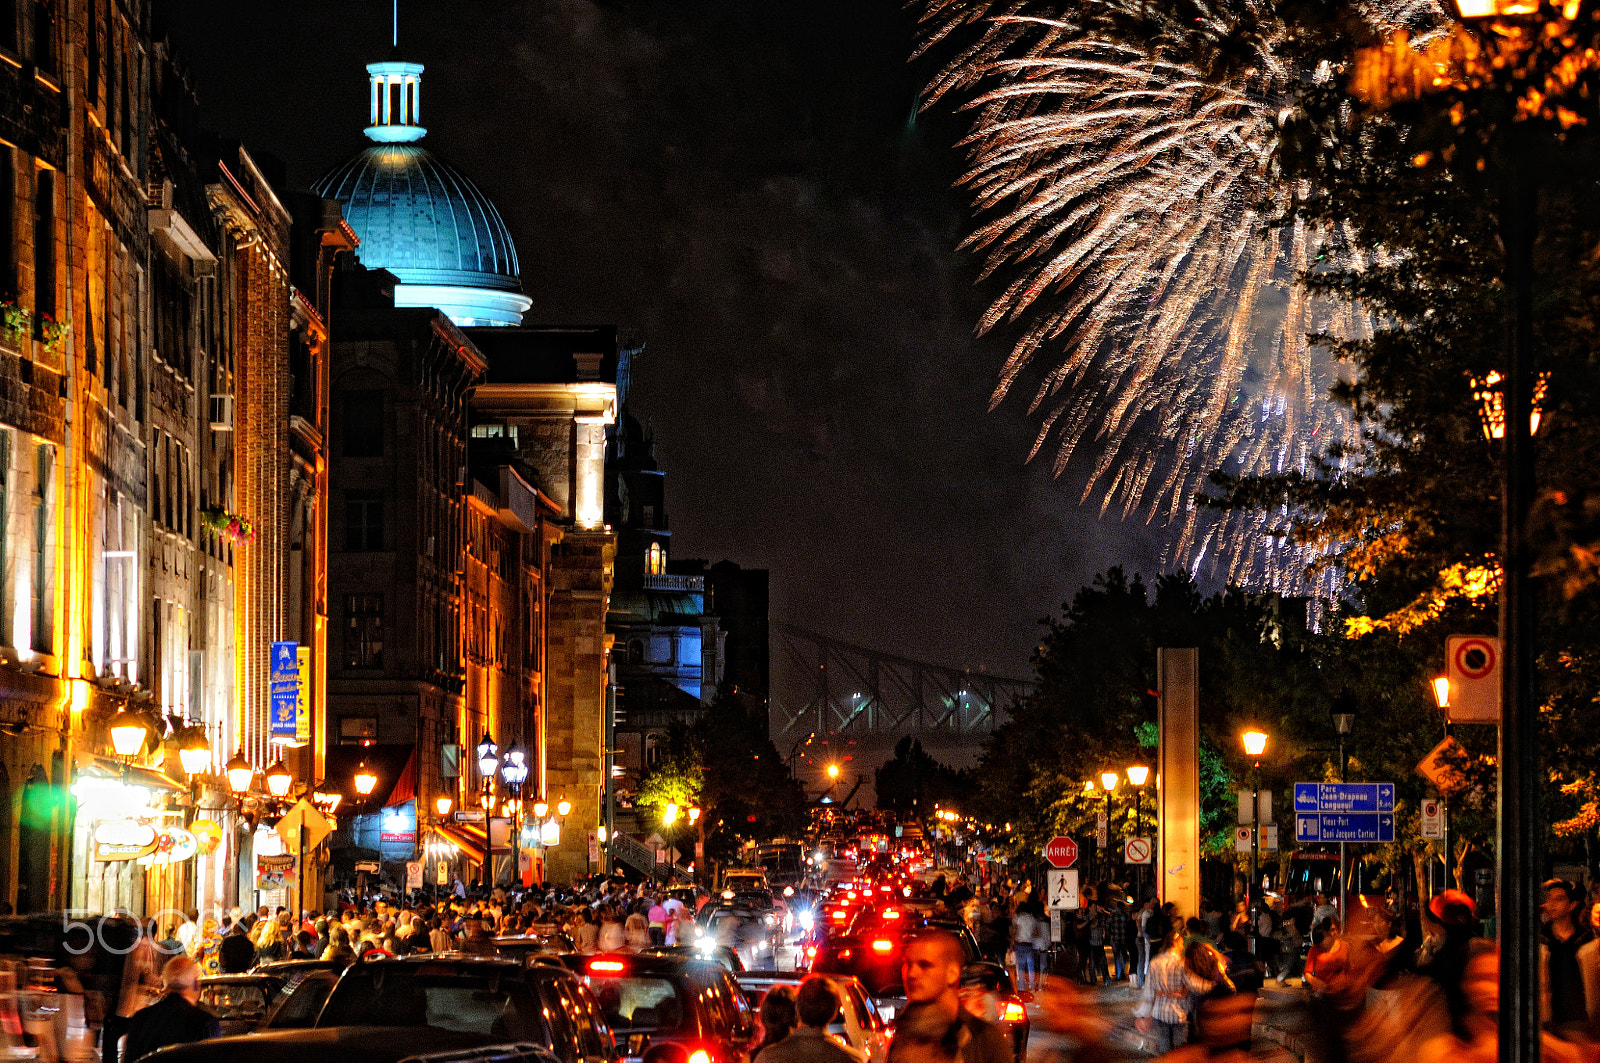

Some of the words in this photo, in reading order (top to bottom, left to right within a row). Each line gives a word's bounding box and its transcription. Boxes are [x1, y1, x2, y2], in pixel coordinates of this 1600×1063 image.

[1321, 785, 1336, 793] Parc
[1321, 801, 1354, 810] Longueuil
[1048, 846, 1076, 857] ARRÊT
